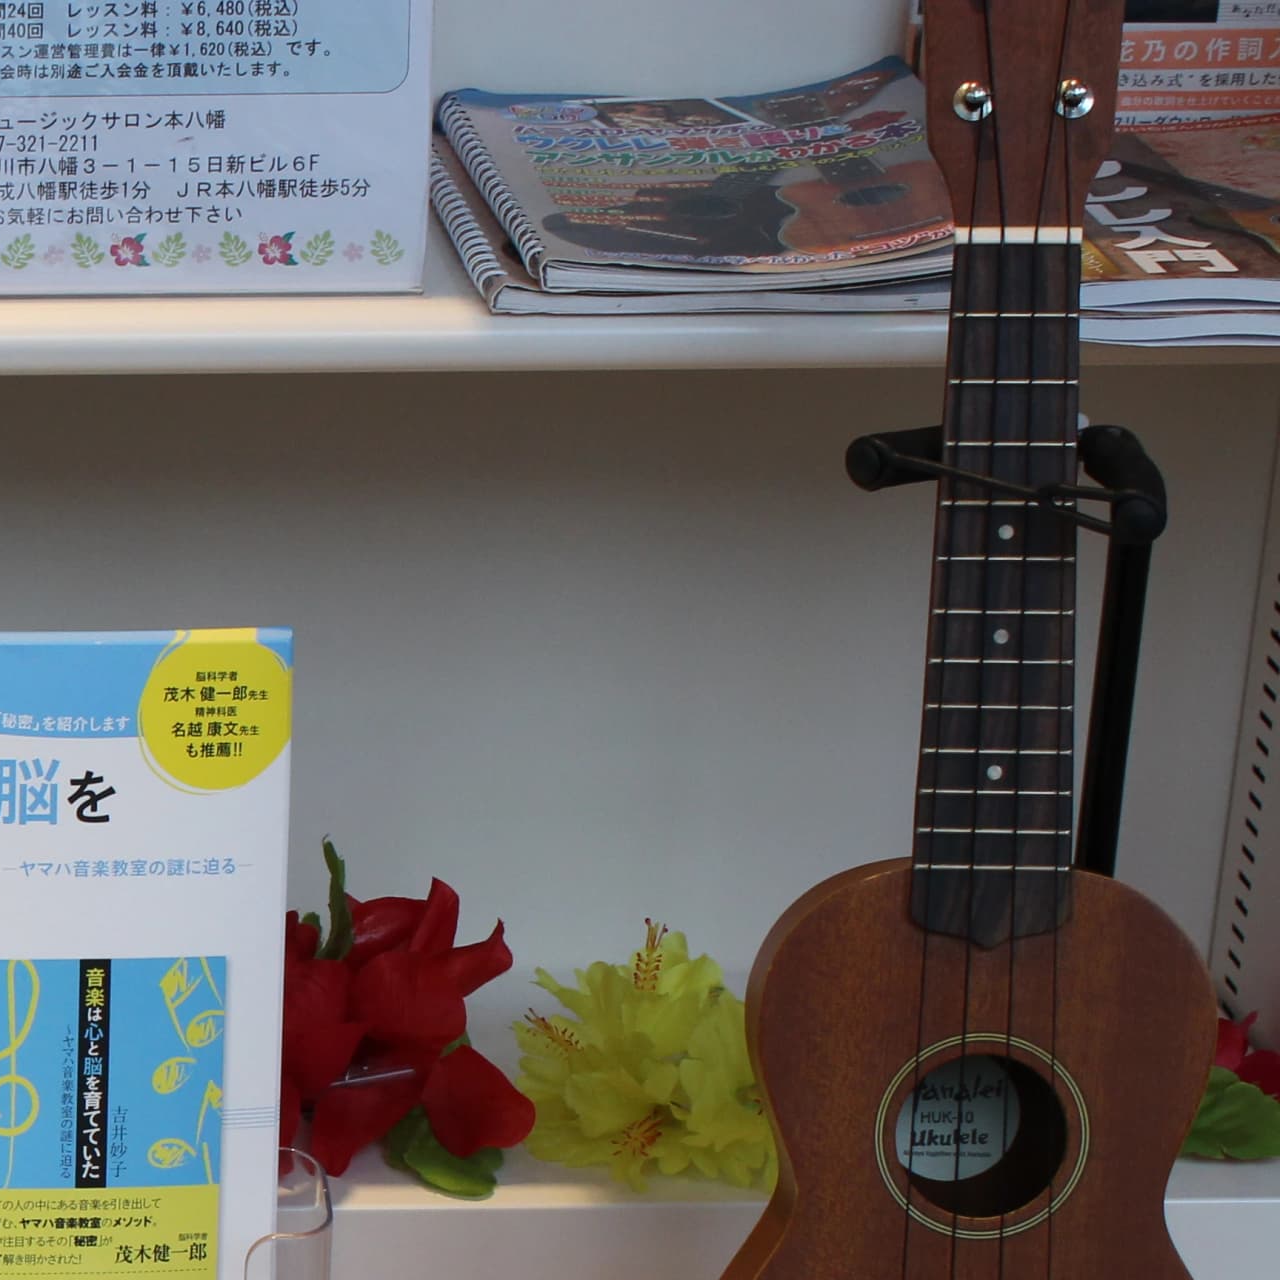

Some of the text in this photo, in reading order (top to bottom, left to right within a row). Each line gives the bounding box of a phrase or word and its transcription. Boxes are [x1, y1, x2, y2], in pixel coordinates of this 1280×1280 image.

[195, 672, 238, 682] 脳科学者
[163, 686, 196, 702] 茂木
[195, 706, 238, 717] 精神科医
[171, 722, 203, 738] 名越
[80, 967, 106, 1180] 音楽は心と脳を育てていた
[110, 1105, 129, 1179] 吉井妙子
[114, 1242, 208, 1265] 茂木健一郎
